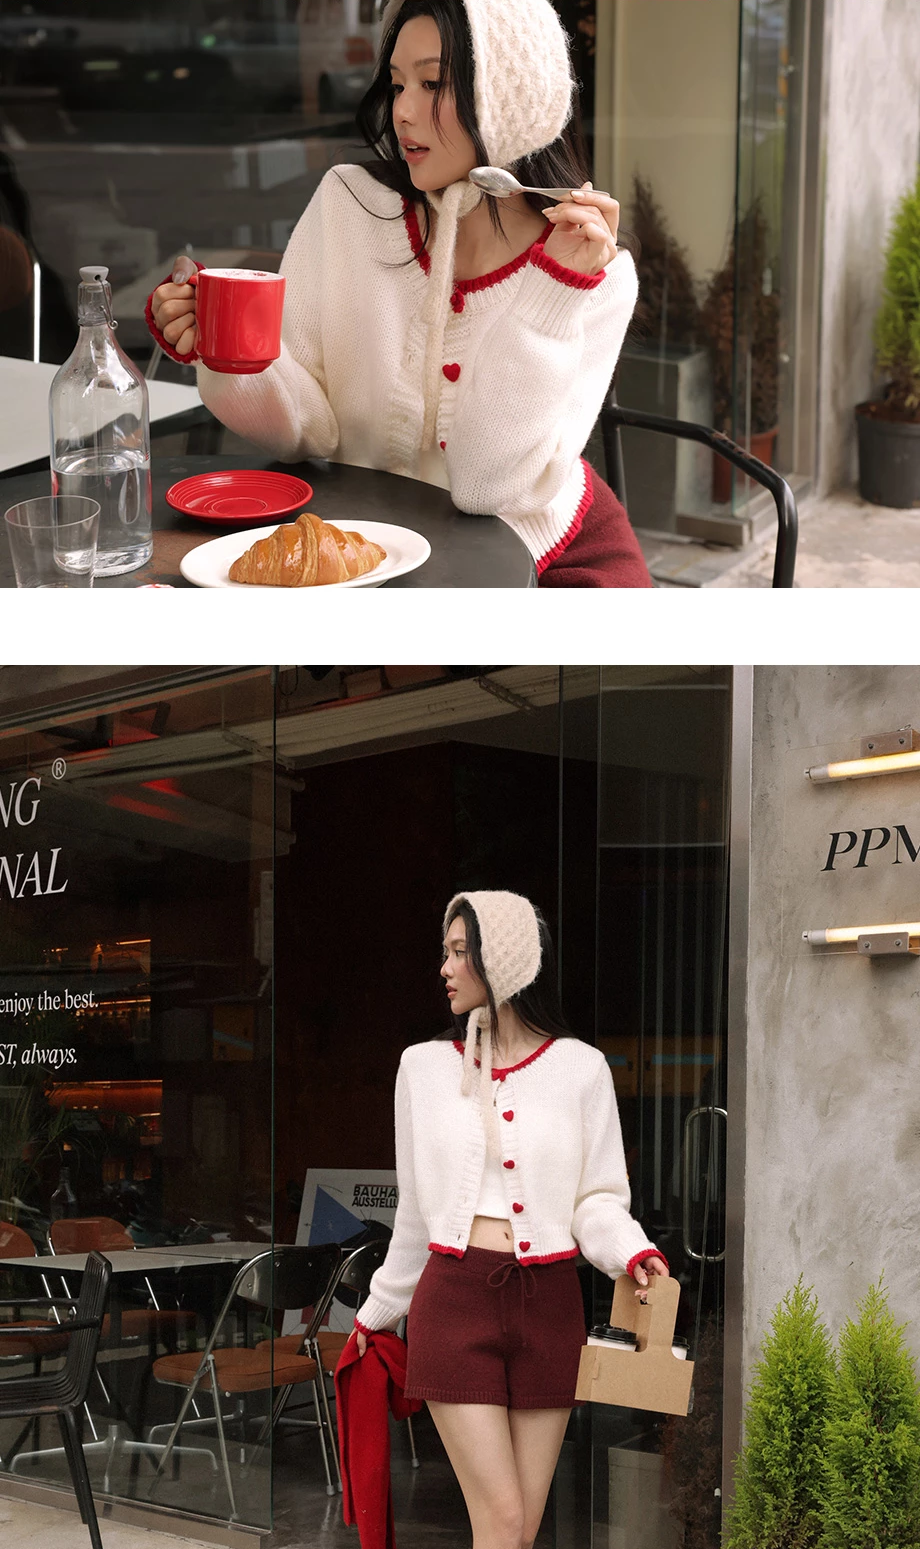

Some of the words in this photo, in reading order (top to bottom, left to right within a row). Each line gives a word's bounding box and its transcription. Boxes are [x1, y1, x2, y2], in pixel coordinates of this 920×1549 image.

[0, 992, 34, 1017] enjoy
[37, 990, 61, 1011] the
[64, 988, 99, 1010] best.
[21, 1042, 78, 1070] always.
